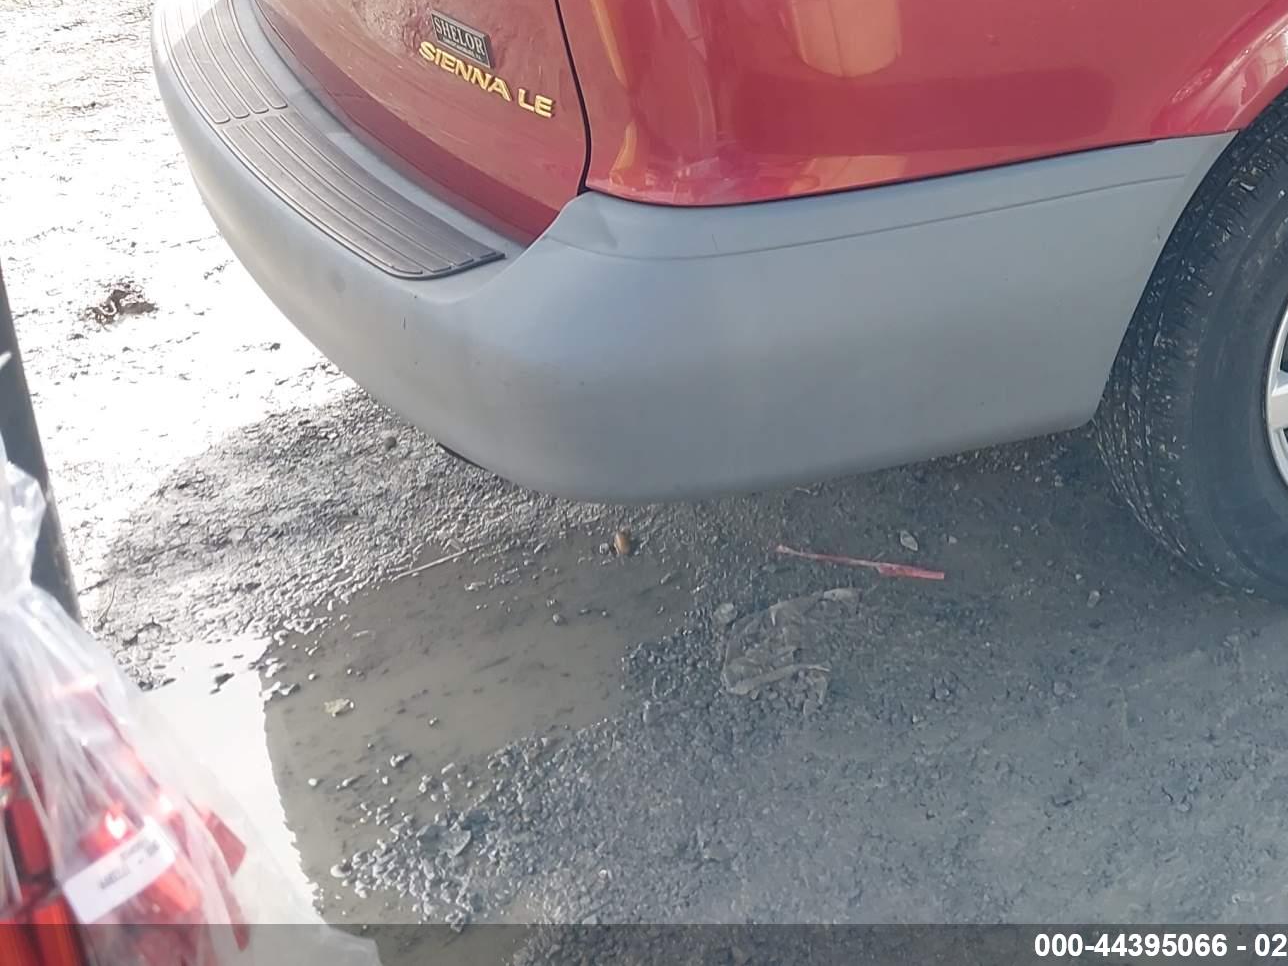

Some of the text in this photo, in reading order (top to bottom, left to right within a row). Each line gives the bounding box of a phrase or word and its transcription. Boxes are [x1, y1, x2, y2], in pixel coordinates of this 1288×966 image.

[434, 16, 486, 56] SHELOR
[418, 40, 512, 102] SIENNA
[517, 87, 554, 118] LE
